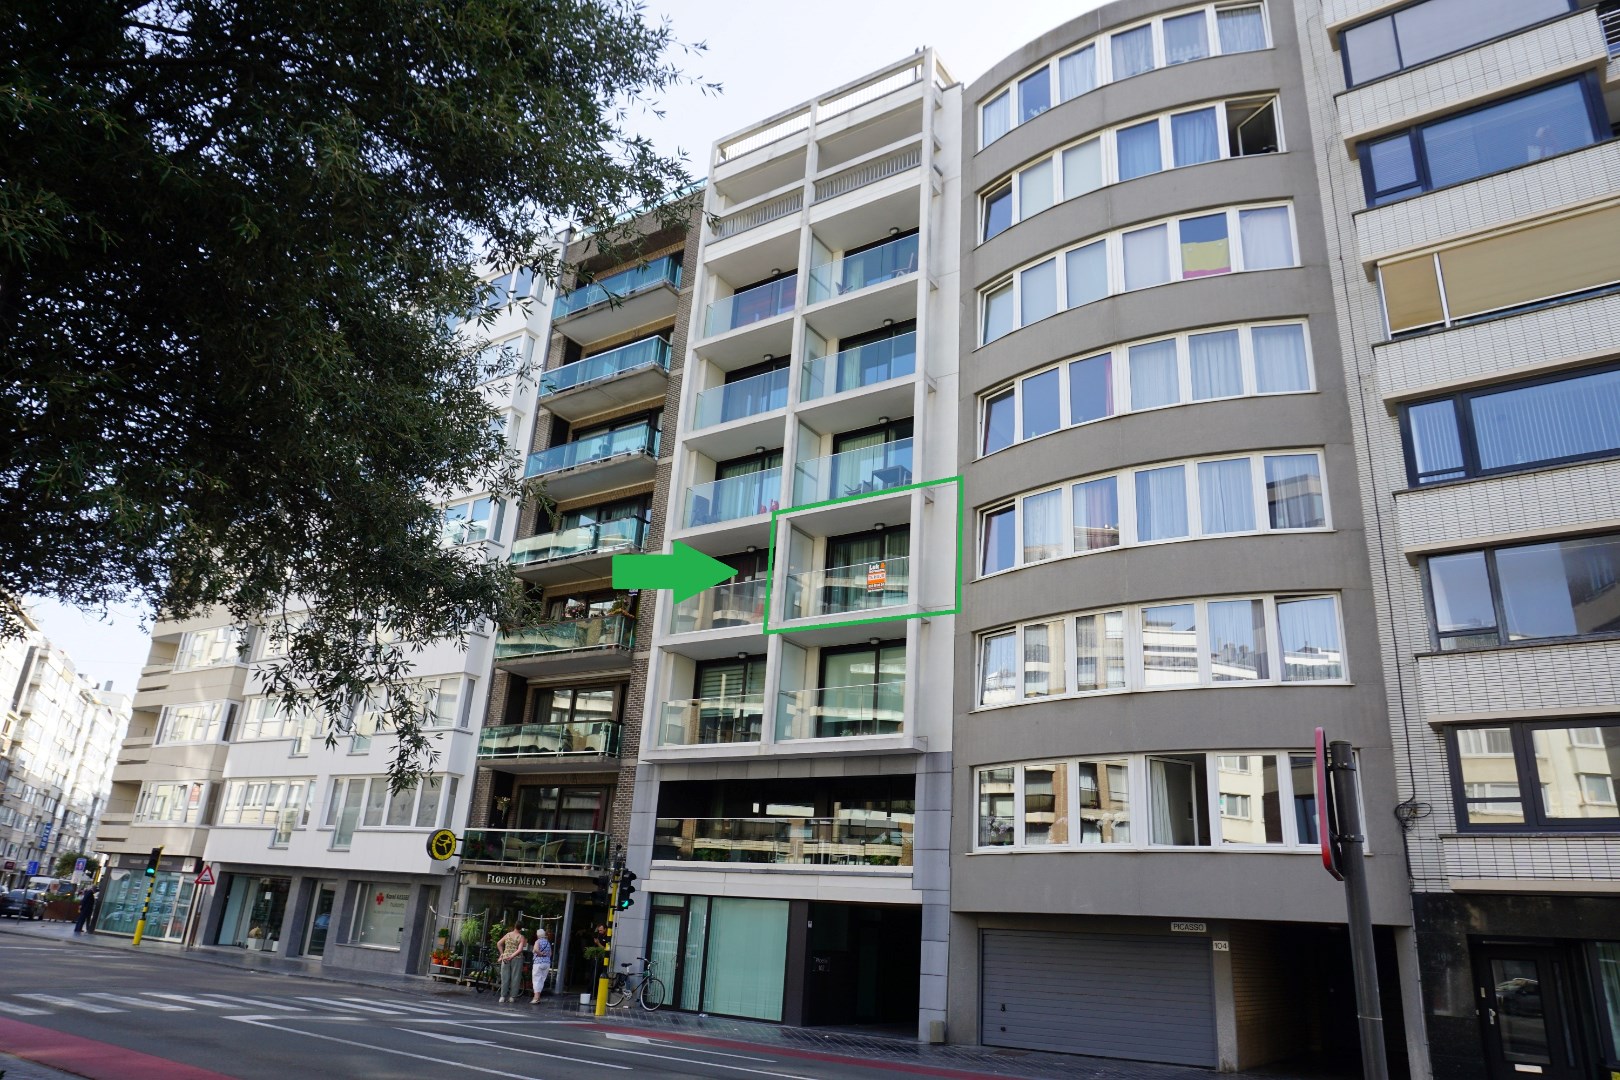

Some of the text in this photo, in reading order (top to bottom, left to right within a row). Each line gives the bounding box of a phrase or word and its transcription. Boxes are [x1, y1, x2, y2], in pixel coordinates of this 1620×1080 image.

[487, 873, 547, 887] FLORIST MEYNS
[1173, 923, 1204, 931] PICASSO
[1214, 942, 1227, 950] 104
